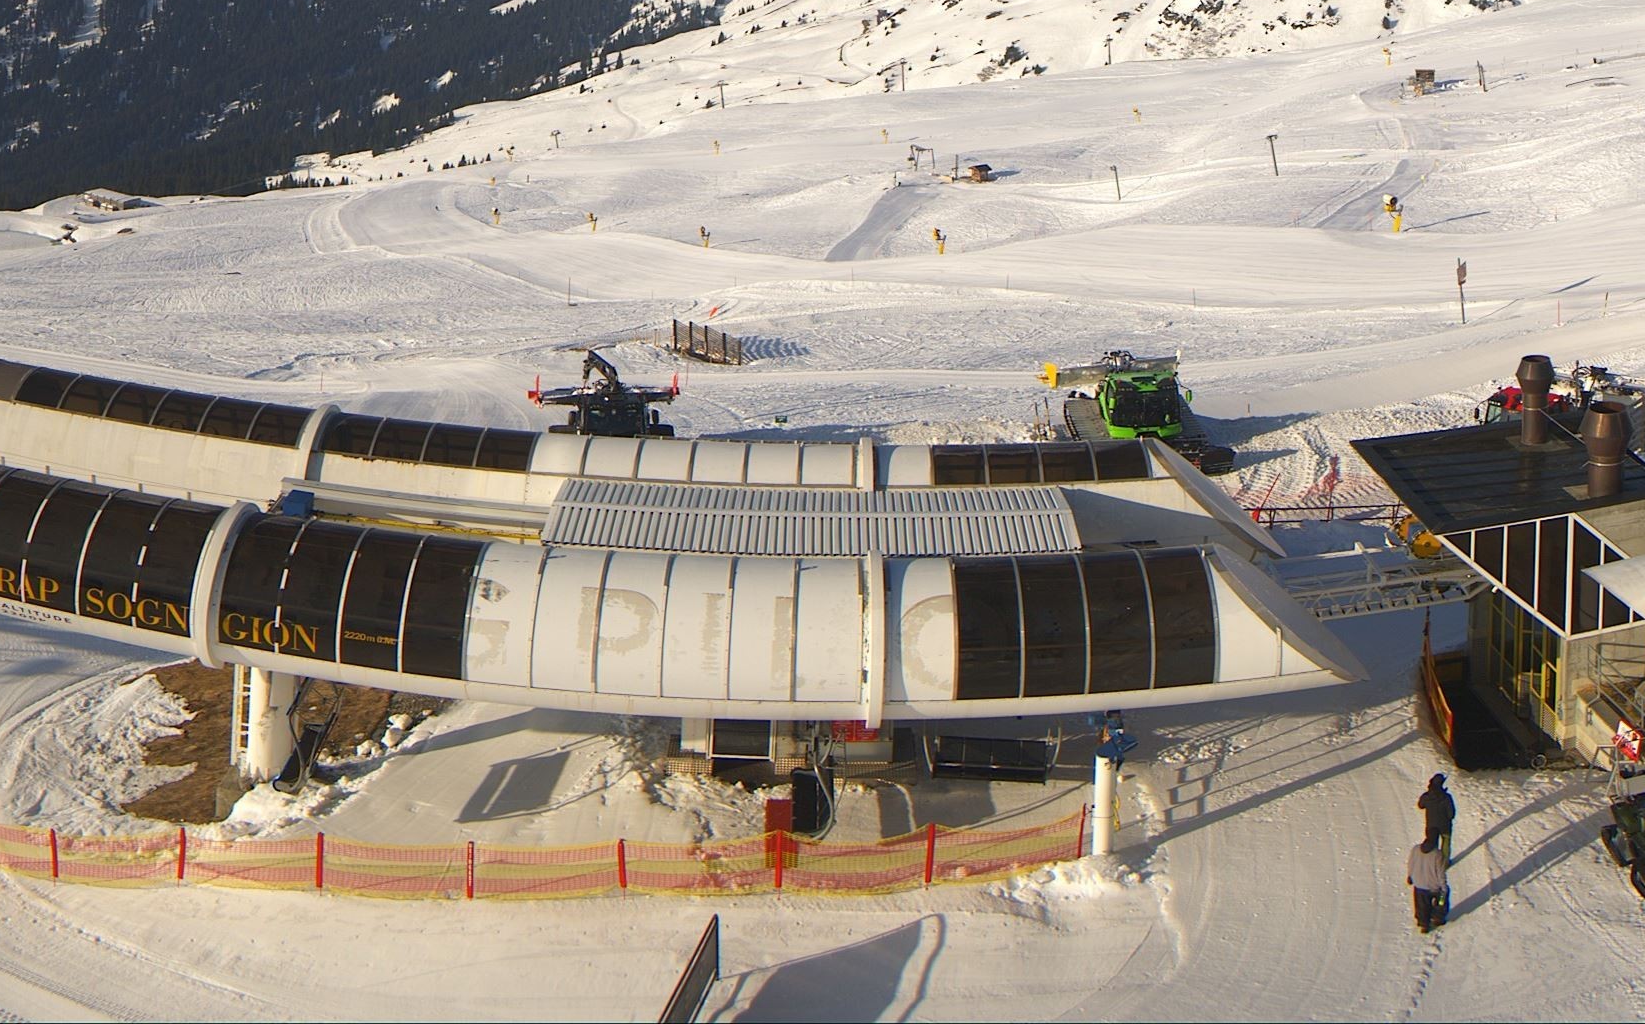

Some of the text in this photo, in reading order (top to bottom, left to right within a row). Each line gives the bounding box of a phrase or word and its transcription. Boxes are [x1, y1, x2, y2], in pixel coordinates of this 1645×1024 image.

[1, 602, 72, 624] ALTITUDE
[85, 587, 189, 631] SOGN
[222, 613, 319, 654] GION
